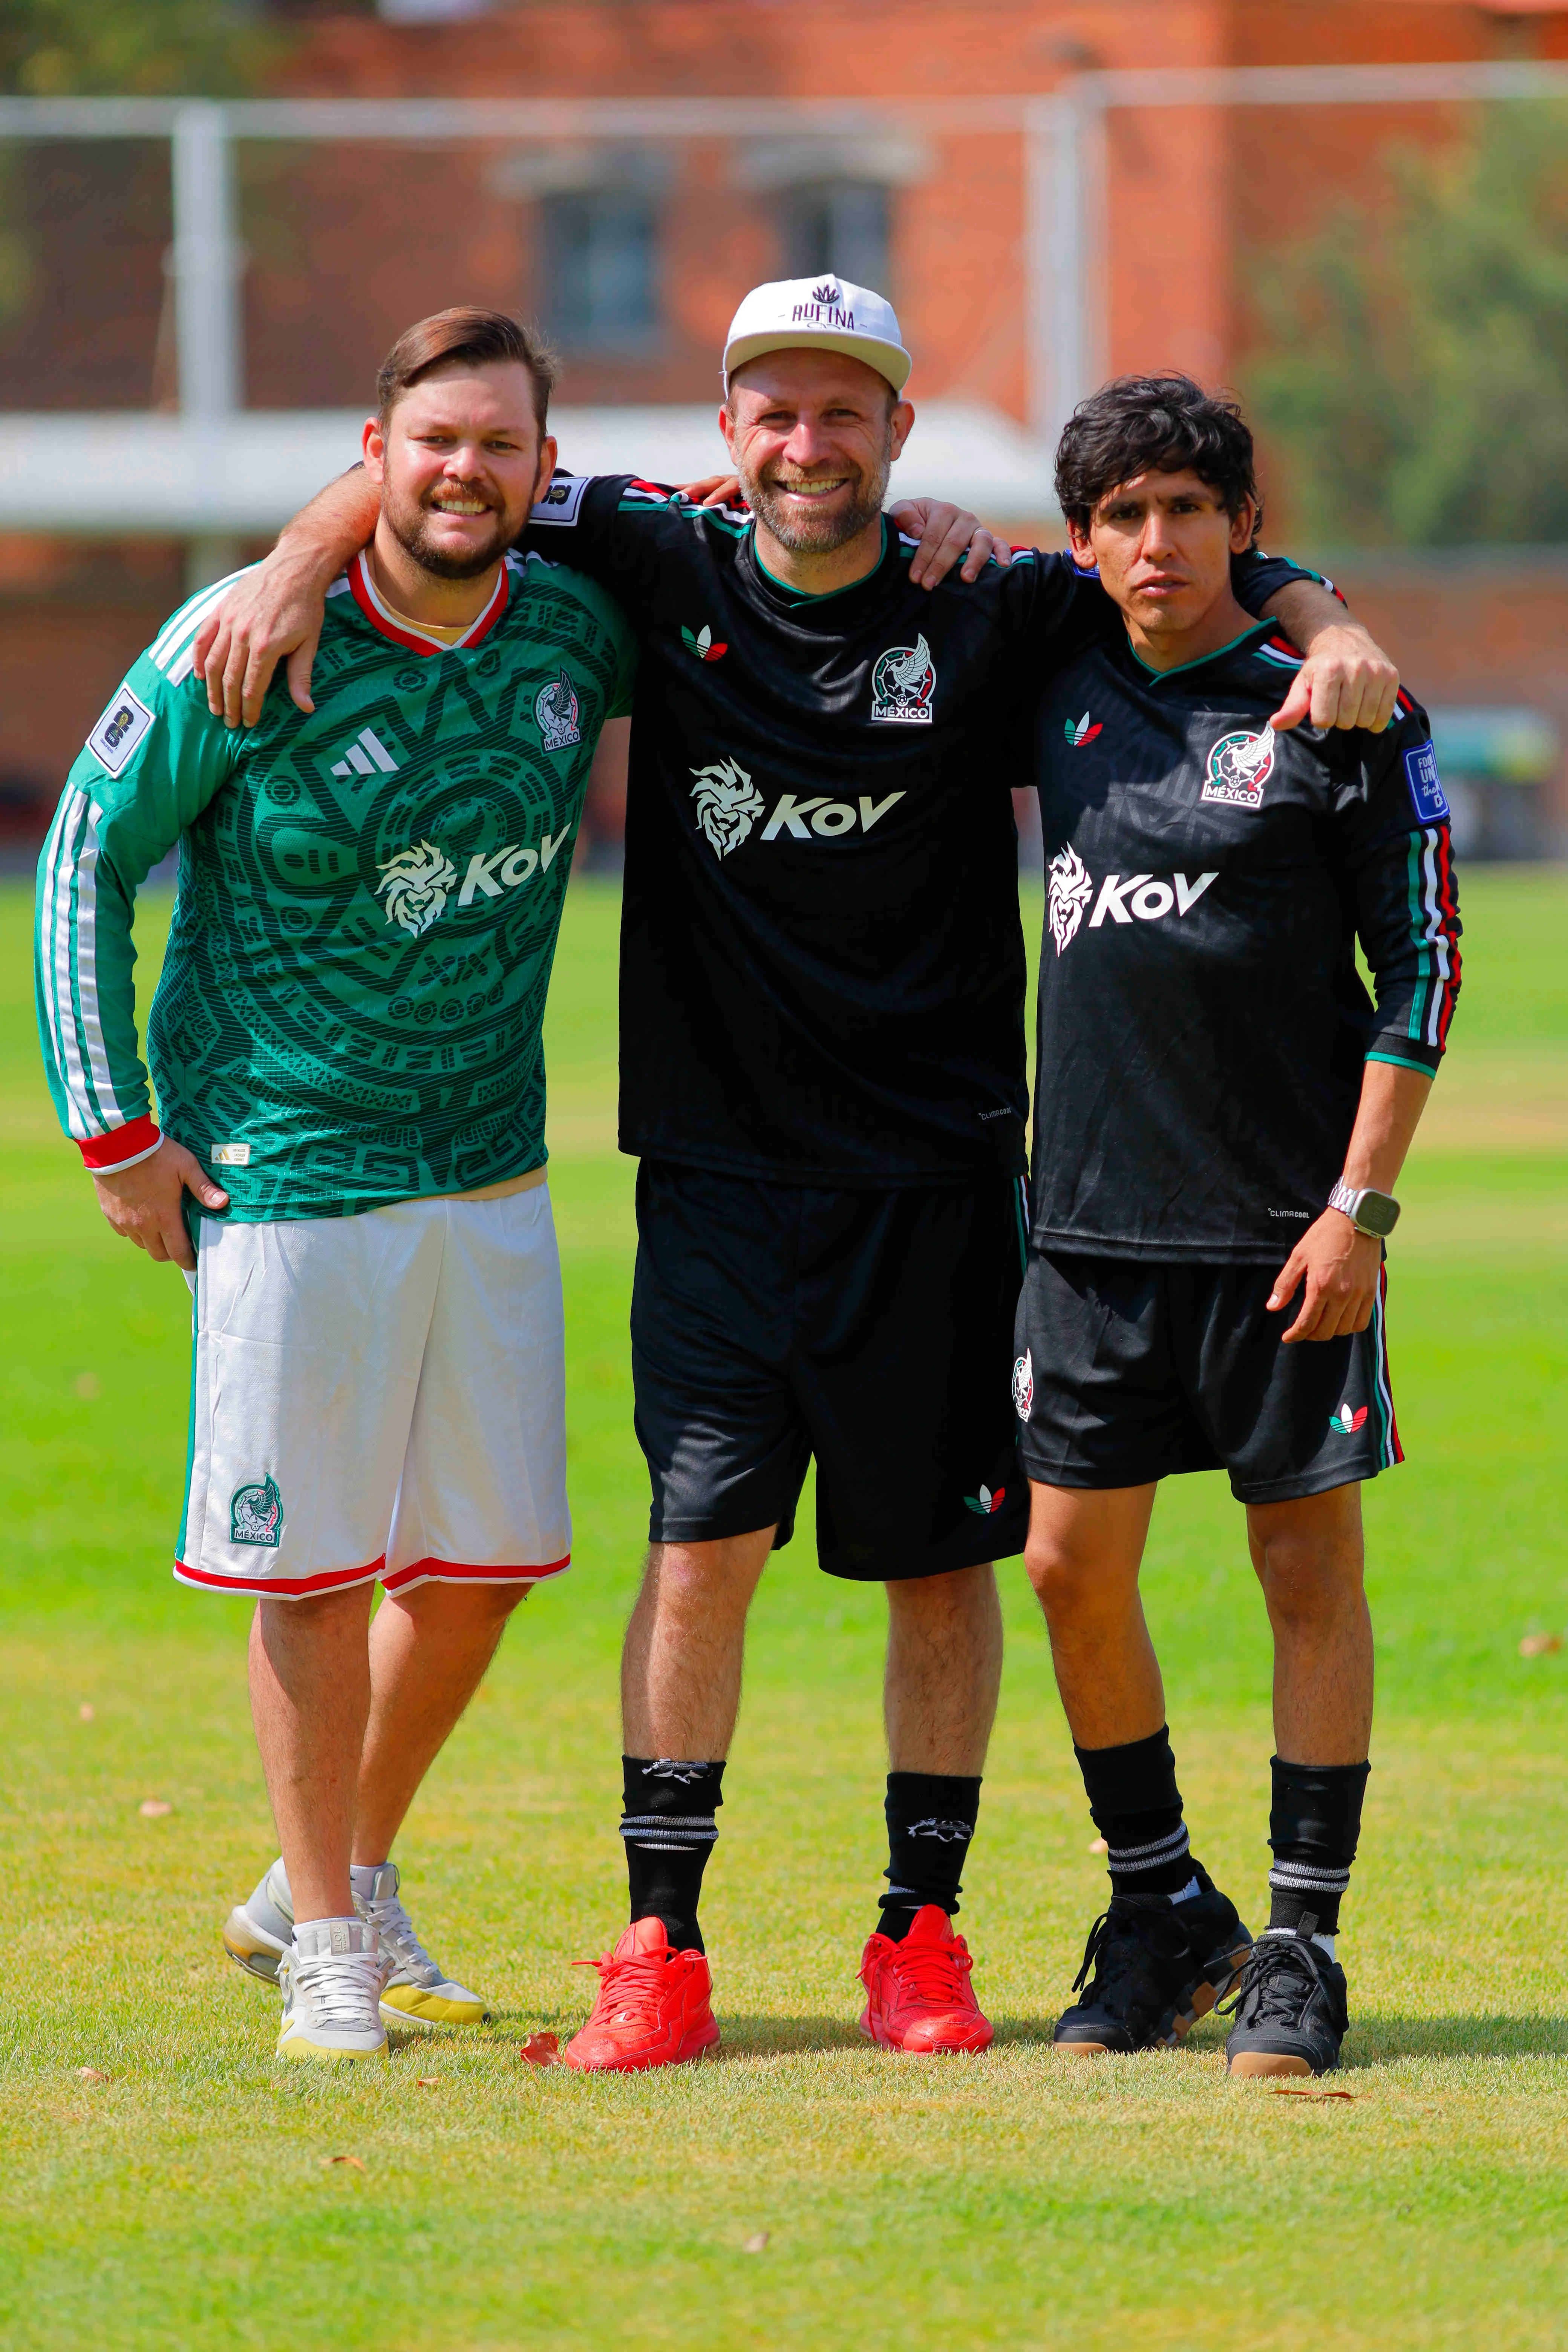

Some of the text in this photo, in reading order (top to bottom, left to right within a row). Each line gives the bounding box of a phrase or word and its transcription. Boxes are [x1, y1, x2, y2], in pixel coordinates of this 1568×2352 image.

[792, 303, 854, 330] RUFINA
[875, 704, 928, 718] MÉXICO
[545, 731, 579, 749] MÉXICO
[1206, 785, 1258, 802] MÉXICO
[235, 1530, 273, 1542] MÉXICO
[334, 1926, 343, 1956] MOTI
